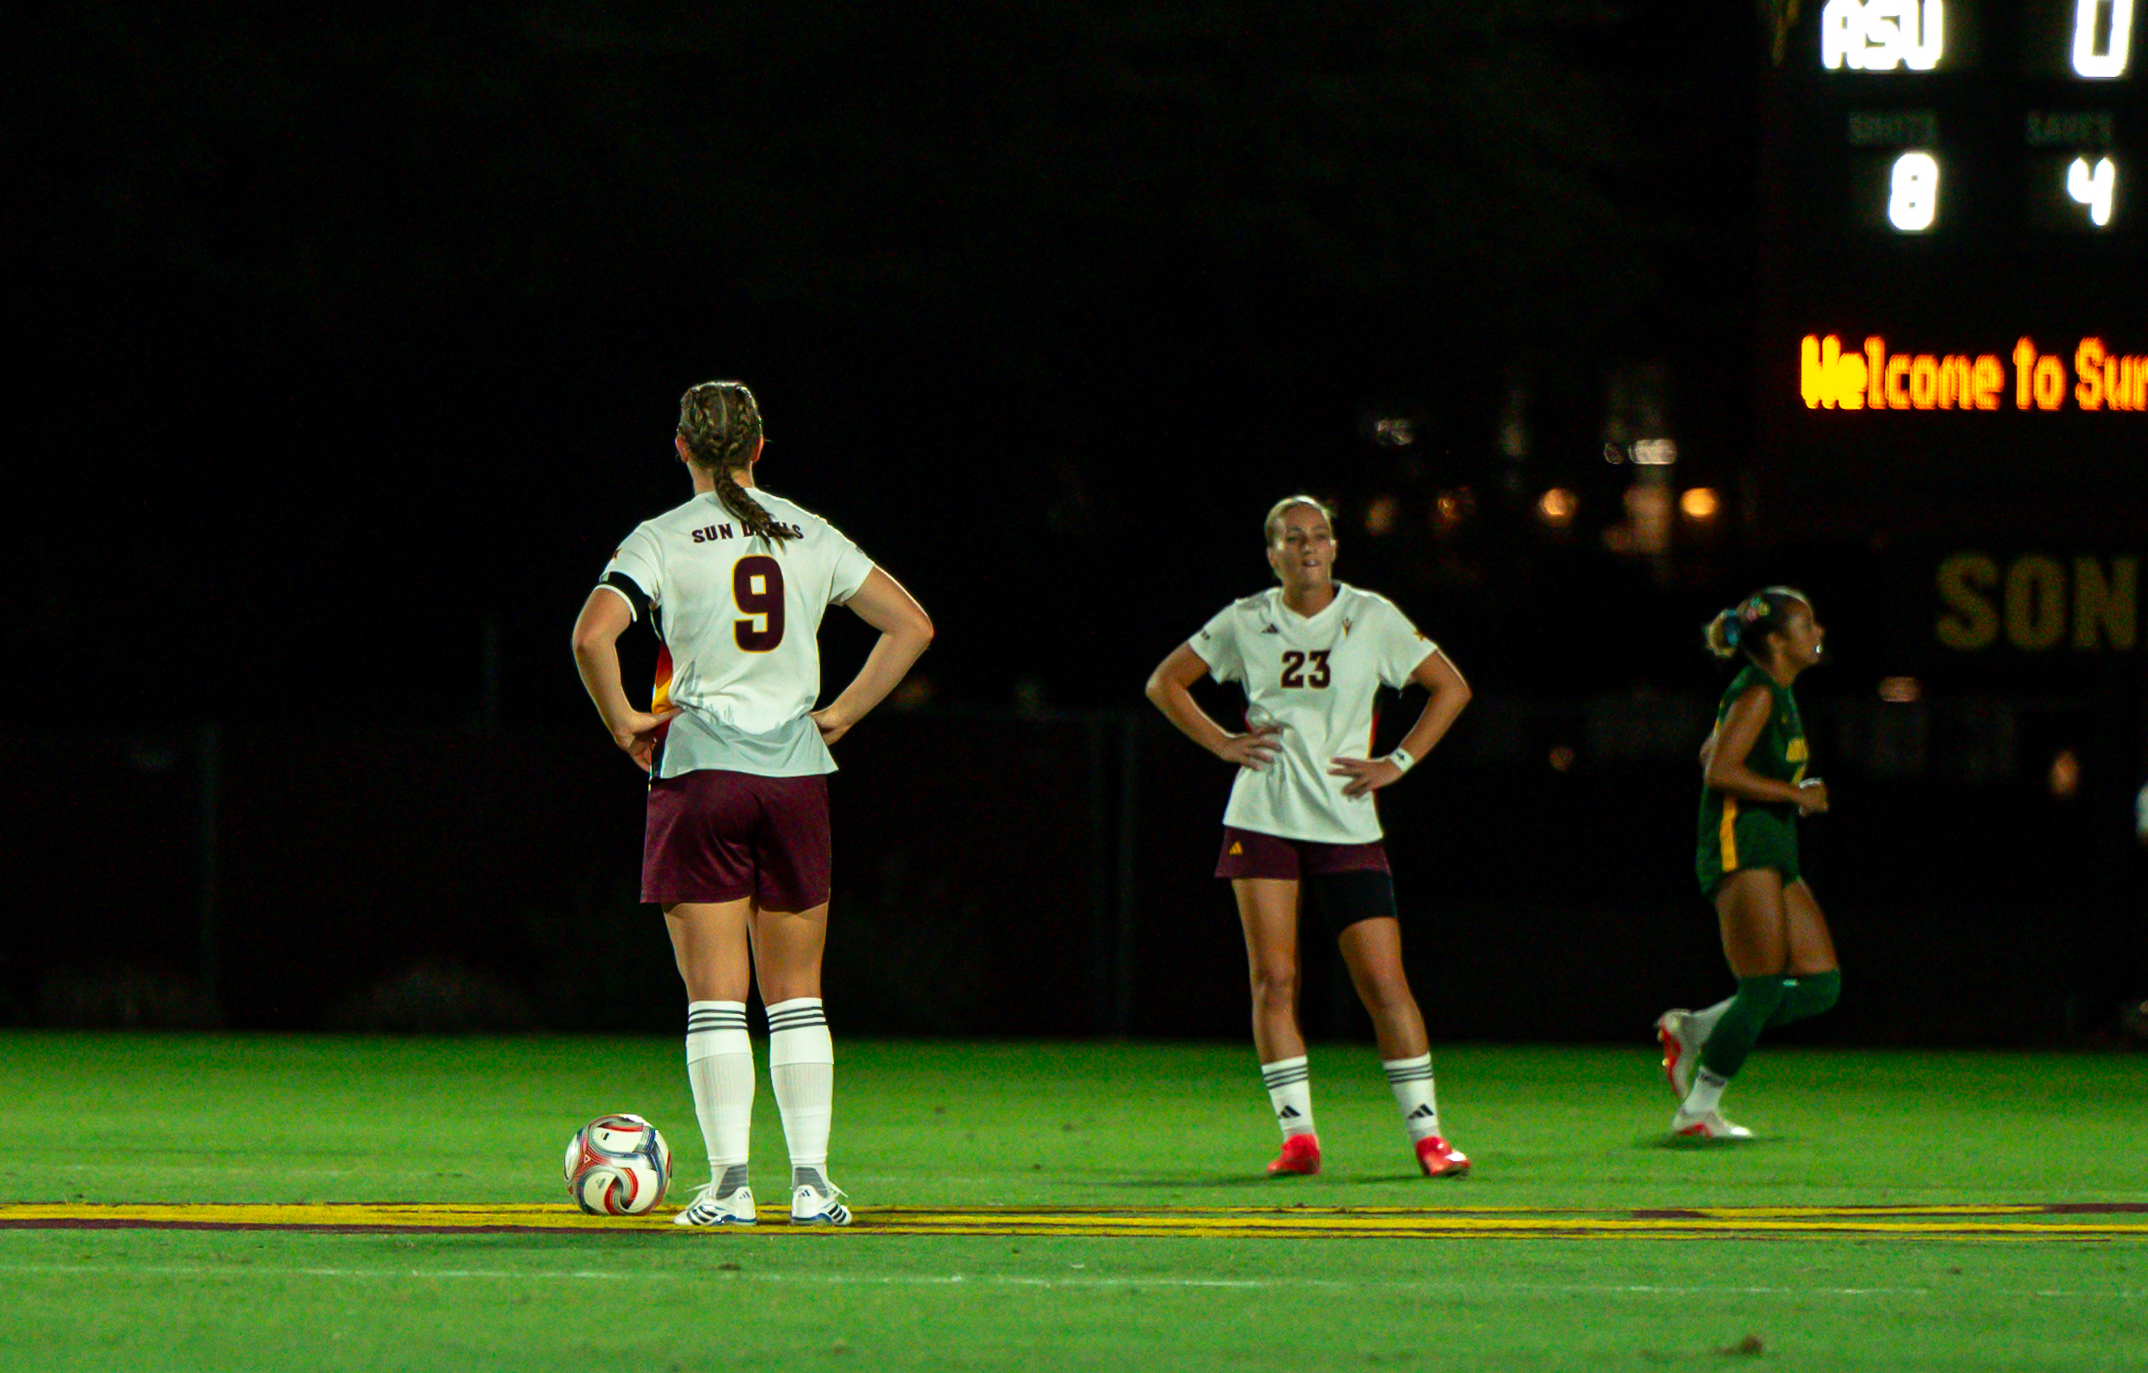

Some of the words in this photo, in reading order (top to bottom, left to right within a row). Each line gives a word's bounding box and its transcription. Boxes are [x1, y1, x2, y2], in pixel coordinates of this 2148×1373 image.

[1821, 0, 1946, 70] ASU
[1888, 152, 1940, 231] 8
[2066, 157, 2115, 226] 4
[1801, 334, 2005, 410] Welcome
[2013, 336, 2066, 411] to
[691, 523, 734, 543] SUN
[732, 555, 784, 652] 9
[1281, 651, 1331, 688] 23
